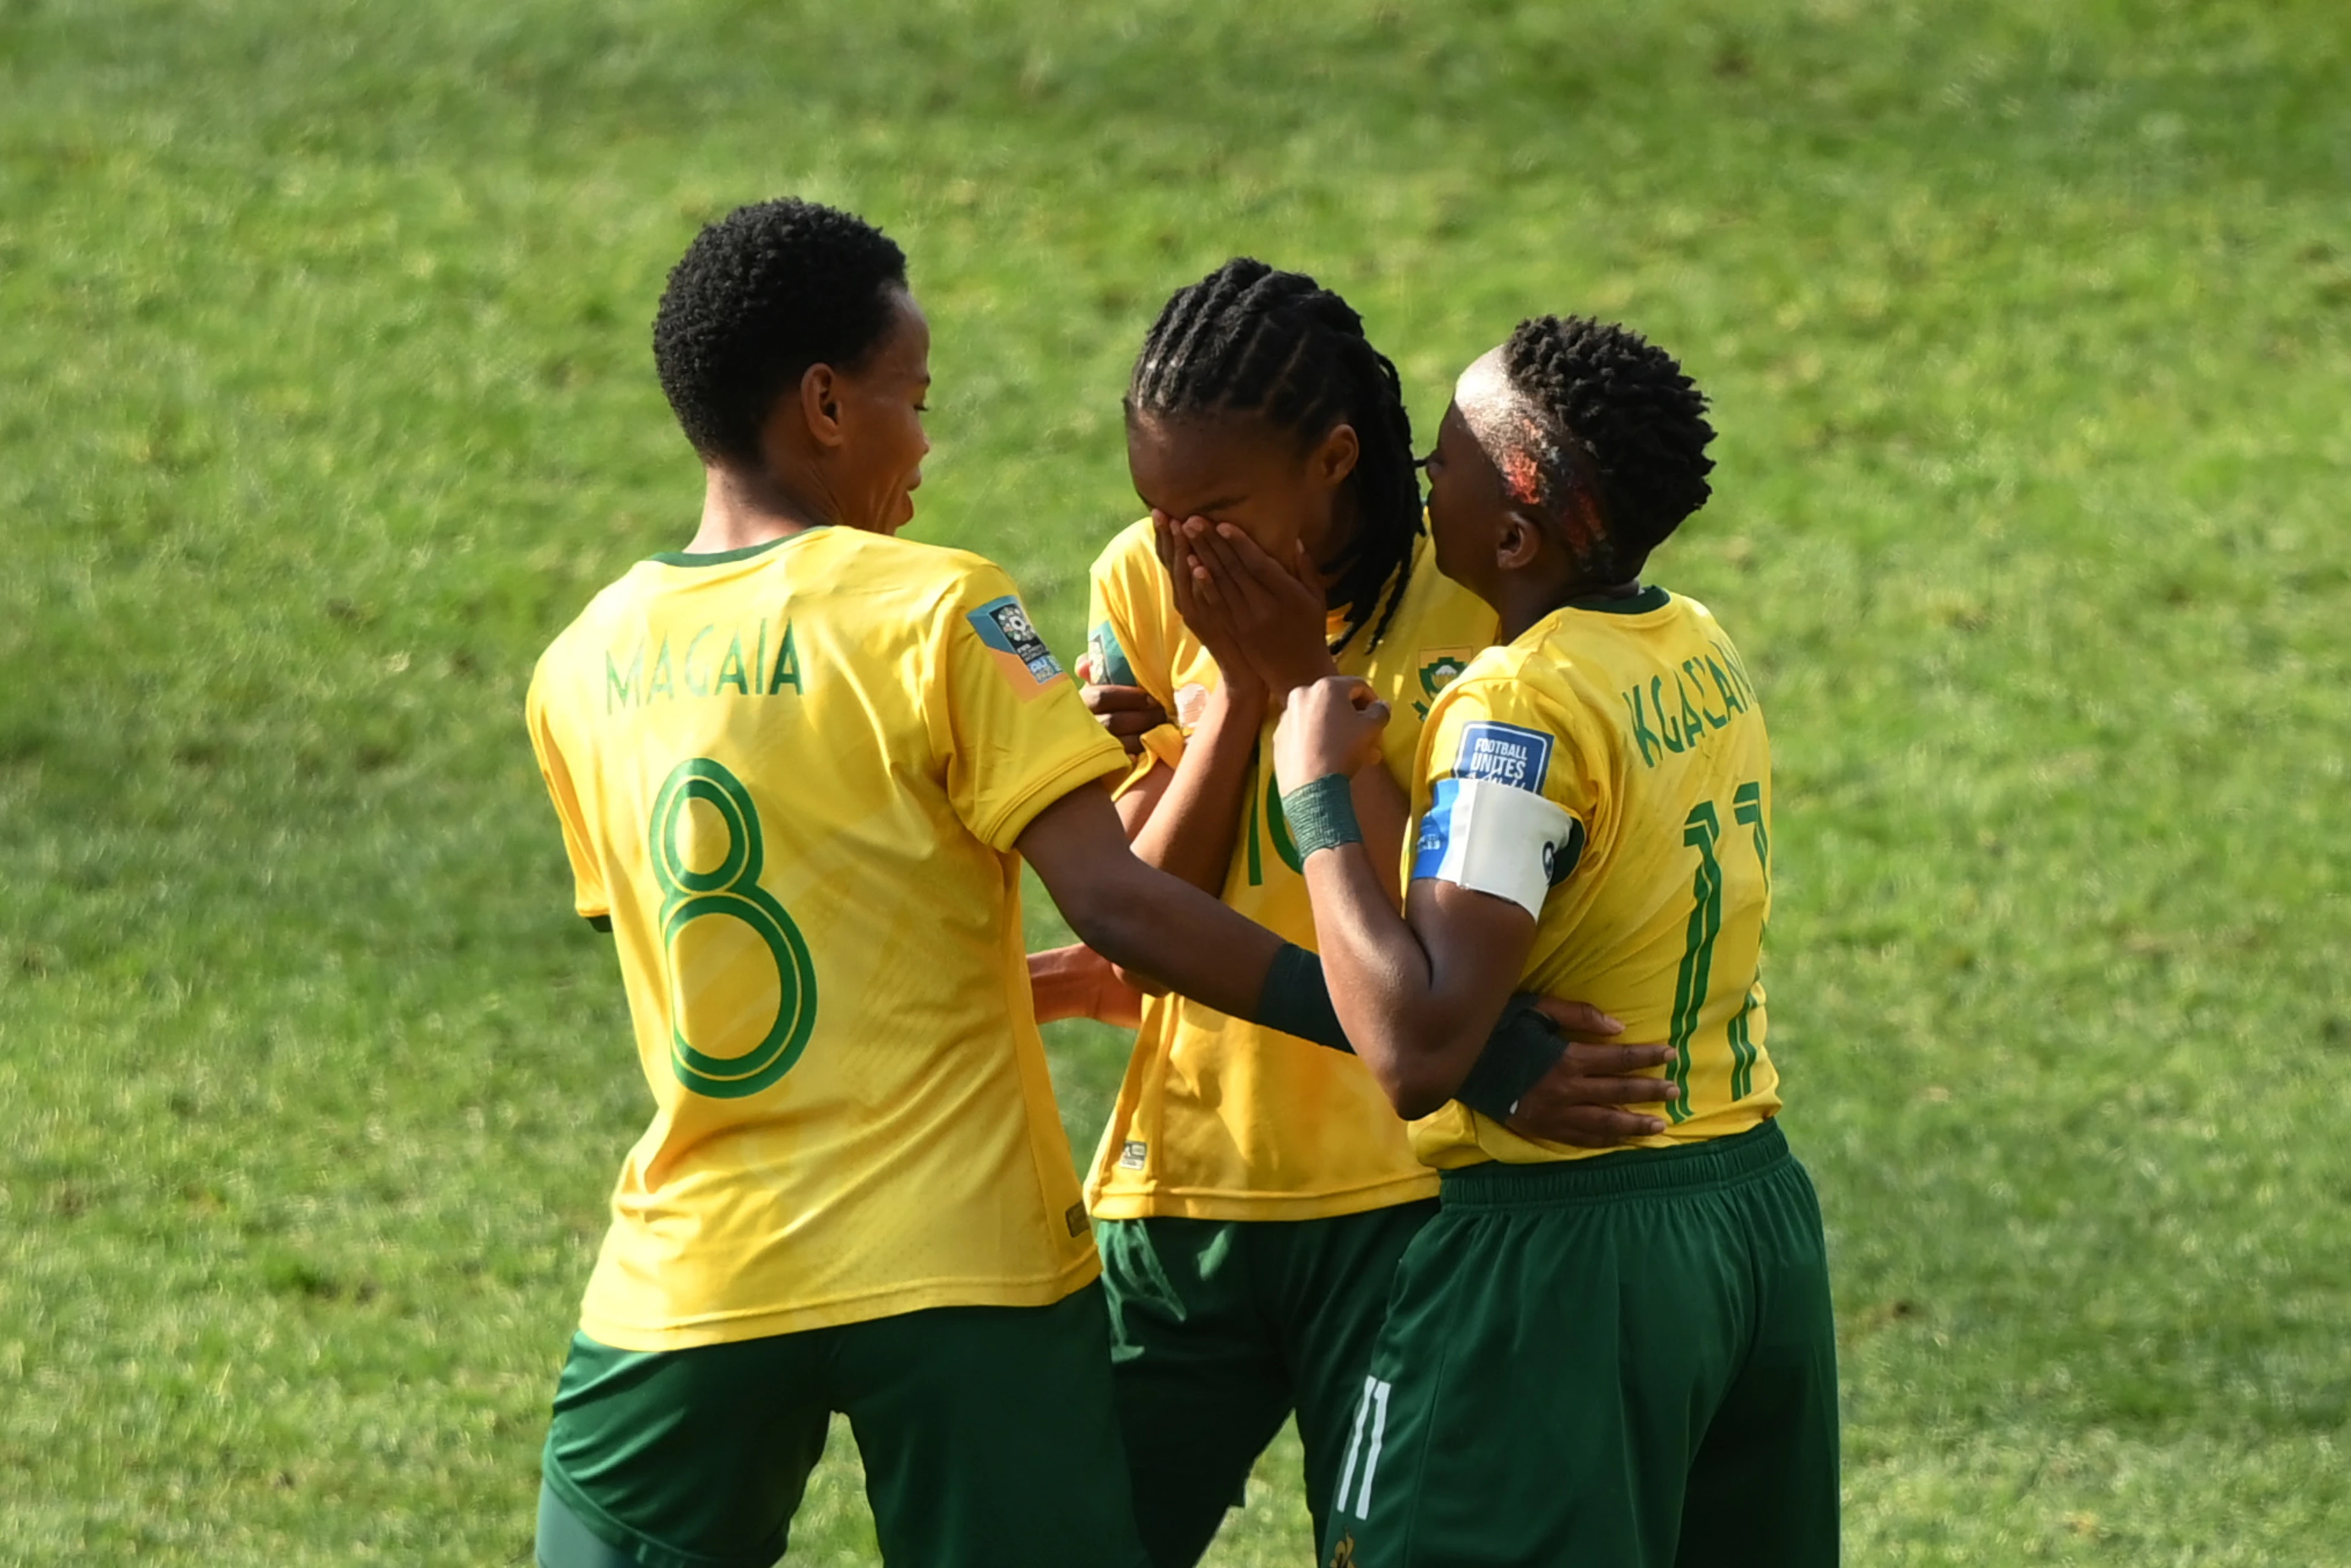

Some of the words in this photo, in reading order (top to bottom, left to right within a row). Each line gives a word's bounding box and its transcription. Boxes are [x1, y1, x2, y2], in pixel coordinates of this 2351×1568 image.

[606, 616, 804, 715] MAGAIA
[1469, 752, 1527, 779] UNITES
[1474, 737, 1528, 761] FOOTBALL
[649, 757, 818, 1099] 8
[1664, 780, 1770, 1125] 11
[1337, 1374, 1392, 1521] 11
